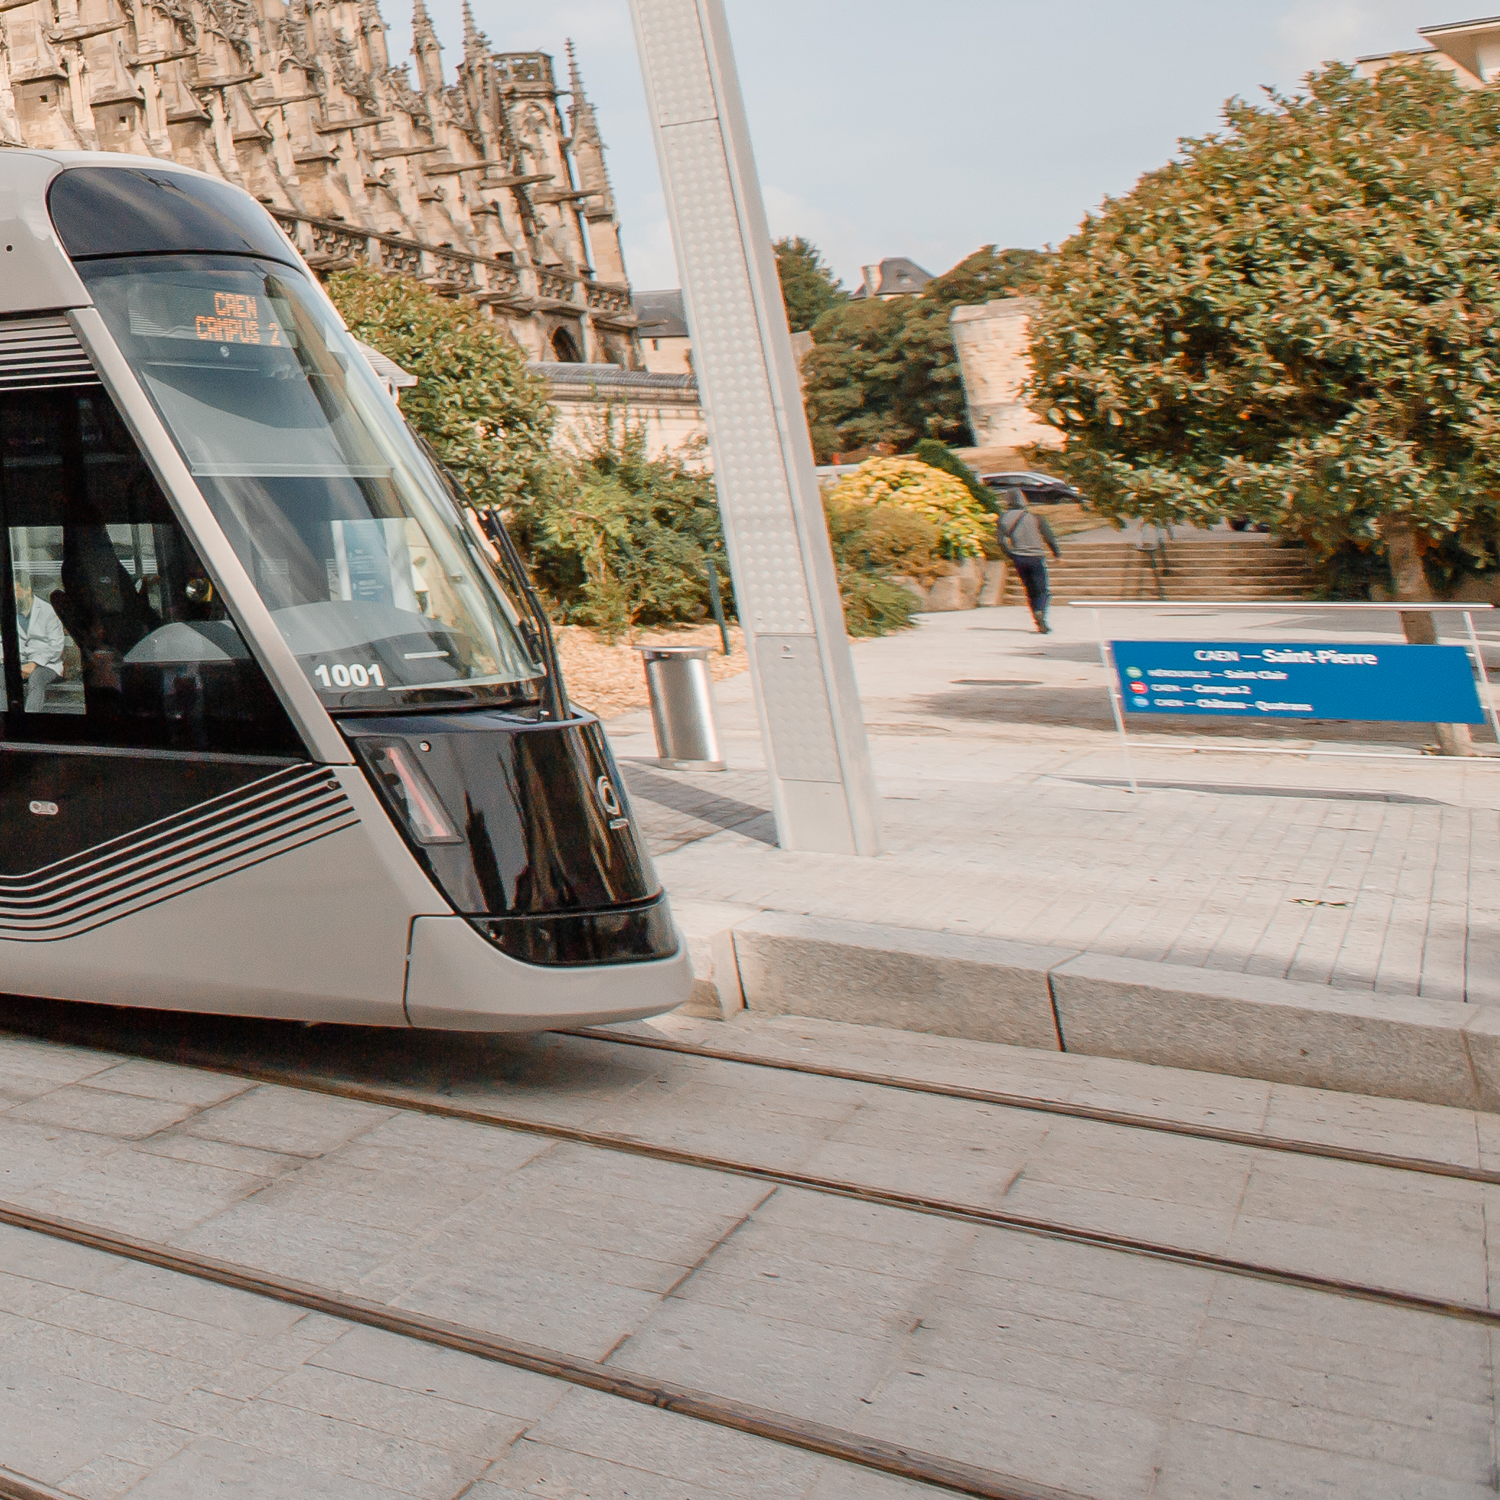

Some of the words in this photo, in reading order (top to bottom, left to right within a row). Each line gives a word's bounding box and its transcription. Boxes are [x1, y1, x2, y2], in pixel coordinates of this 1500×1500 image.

[214, 292, 258, 320] CAEN
[195, 315, 261, 344] CAMPUS
[268, 322, 281, 346] 2
[1193, 649, 1240, 662] CAEN
[1262, 649, 1378, 665] Saint-Pierre
[314, 663, 385, 687] 1001
